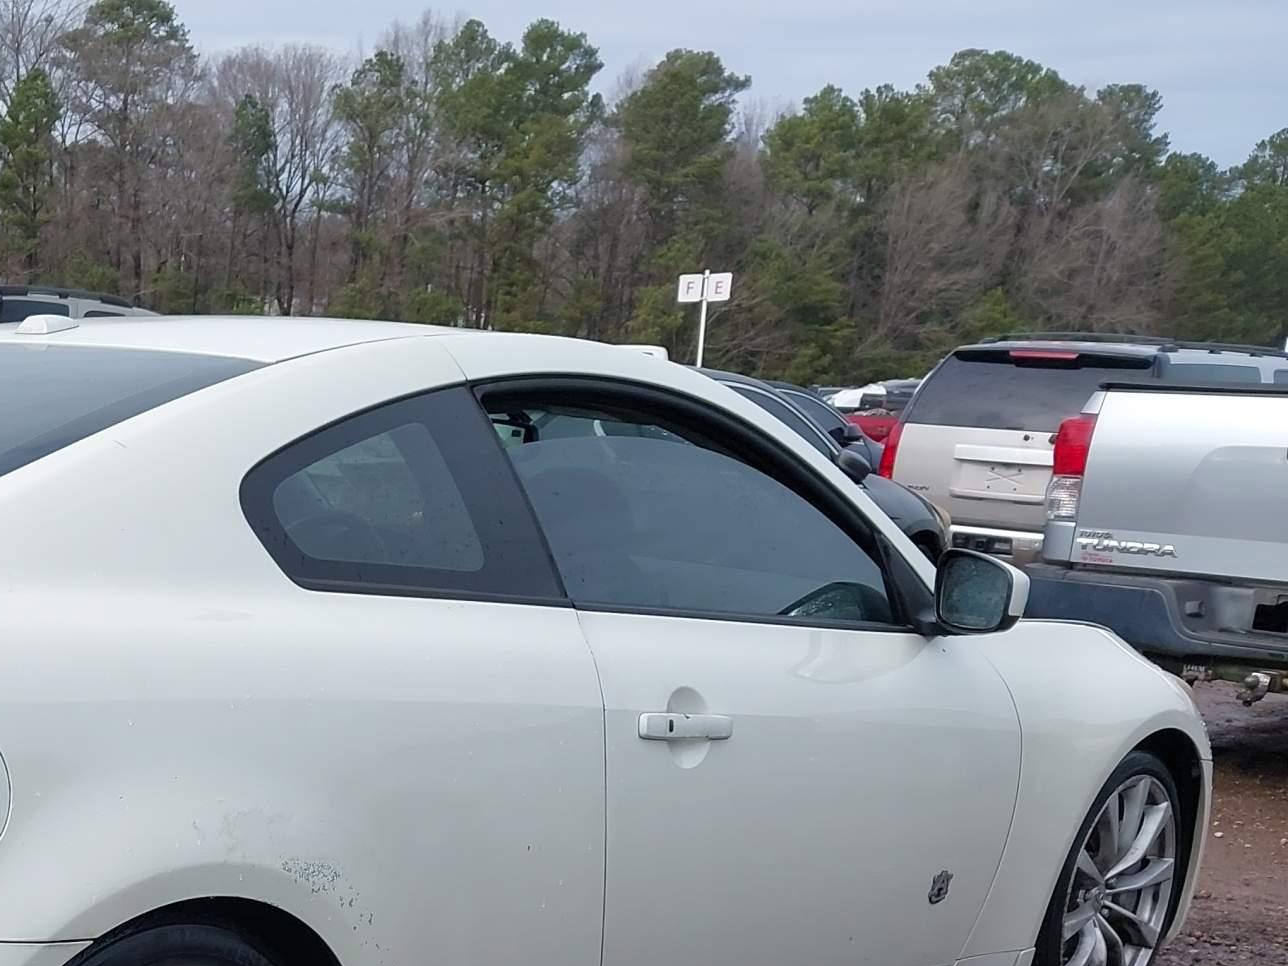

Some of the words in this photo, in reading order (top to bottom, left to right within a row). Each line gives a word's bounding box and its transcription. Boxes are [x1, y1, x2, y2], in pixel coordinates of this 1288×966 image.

[686, 281, 695, 295] F
[715, 281, 724, 295] E
[1076, 538, 1178, 558] TUNDRA
